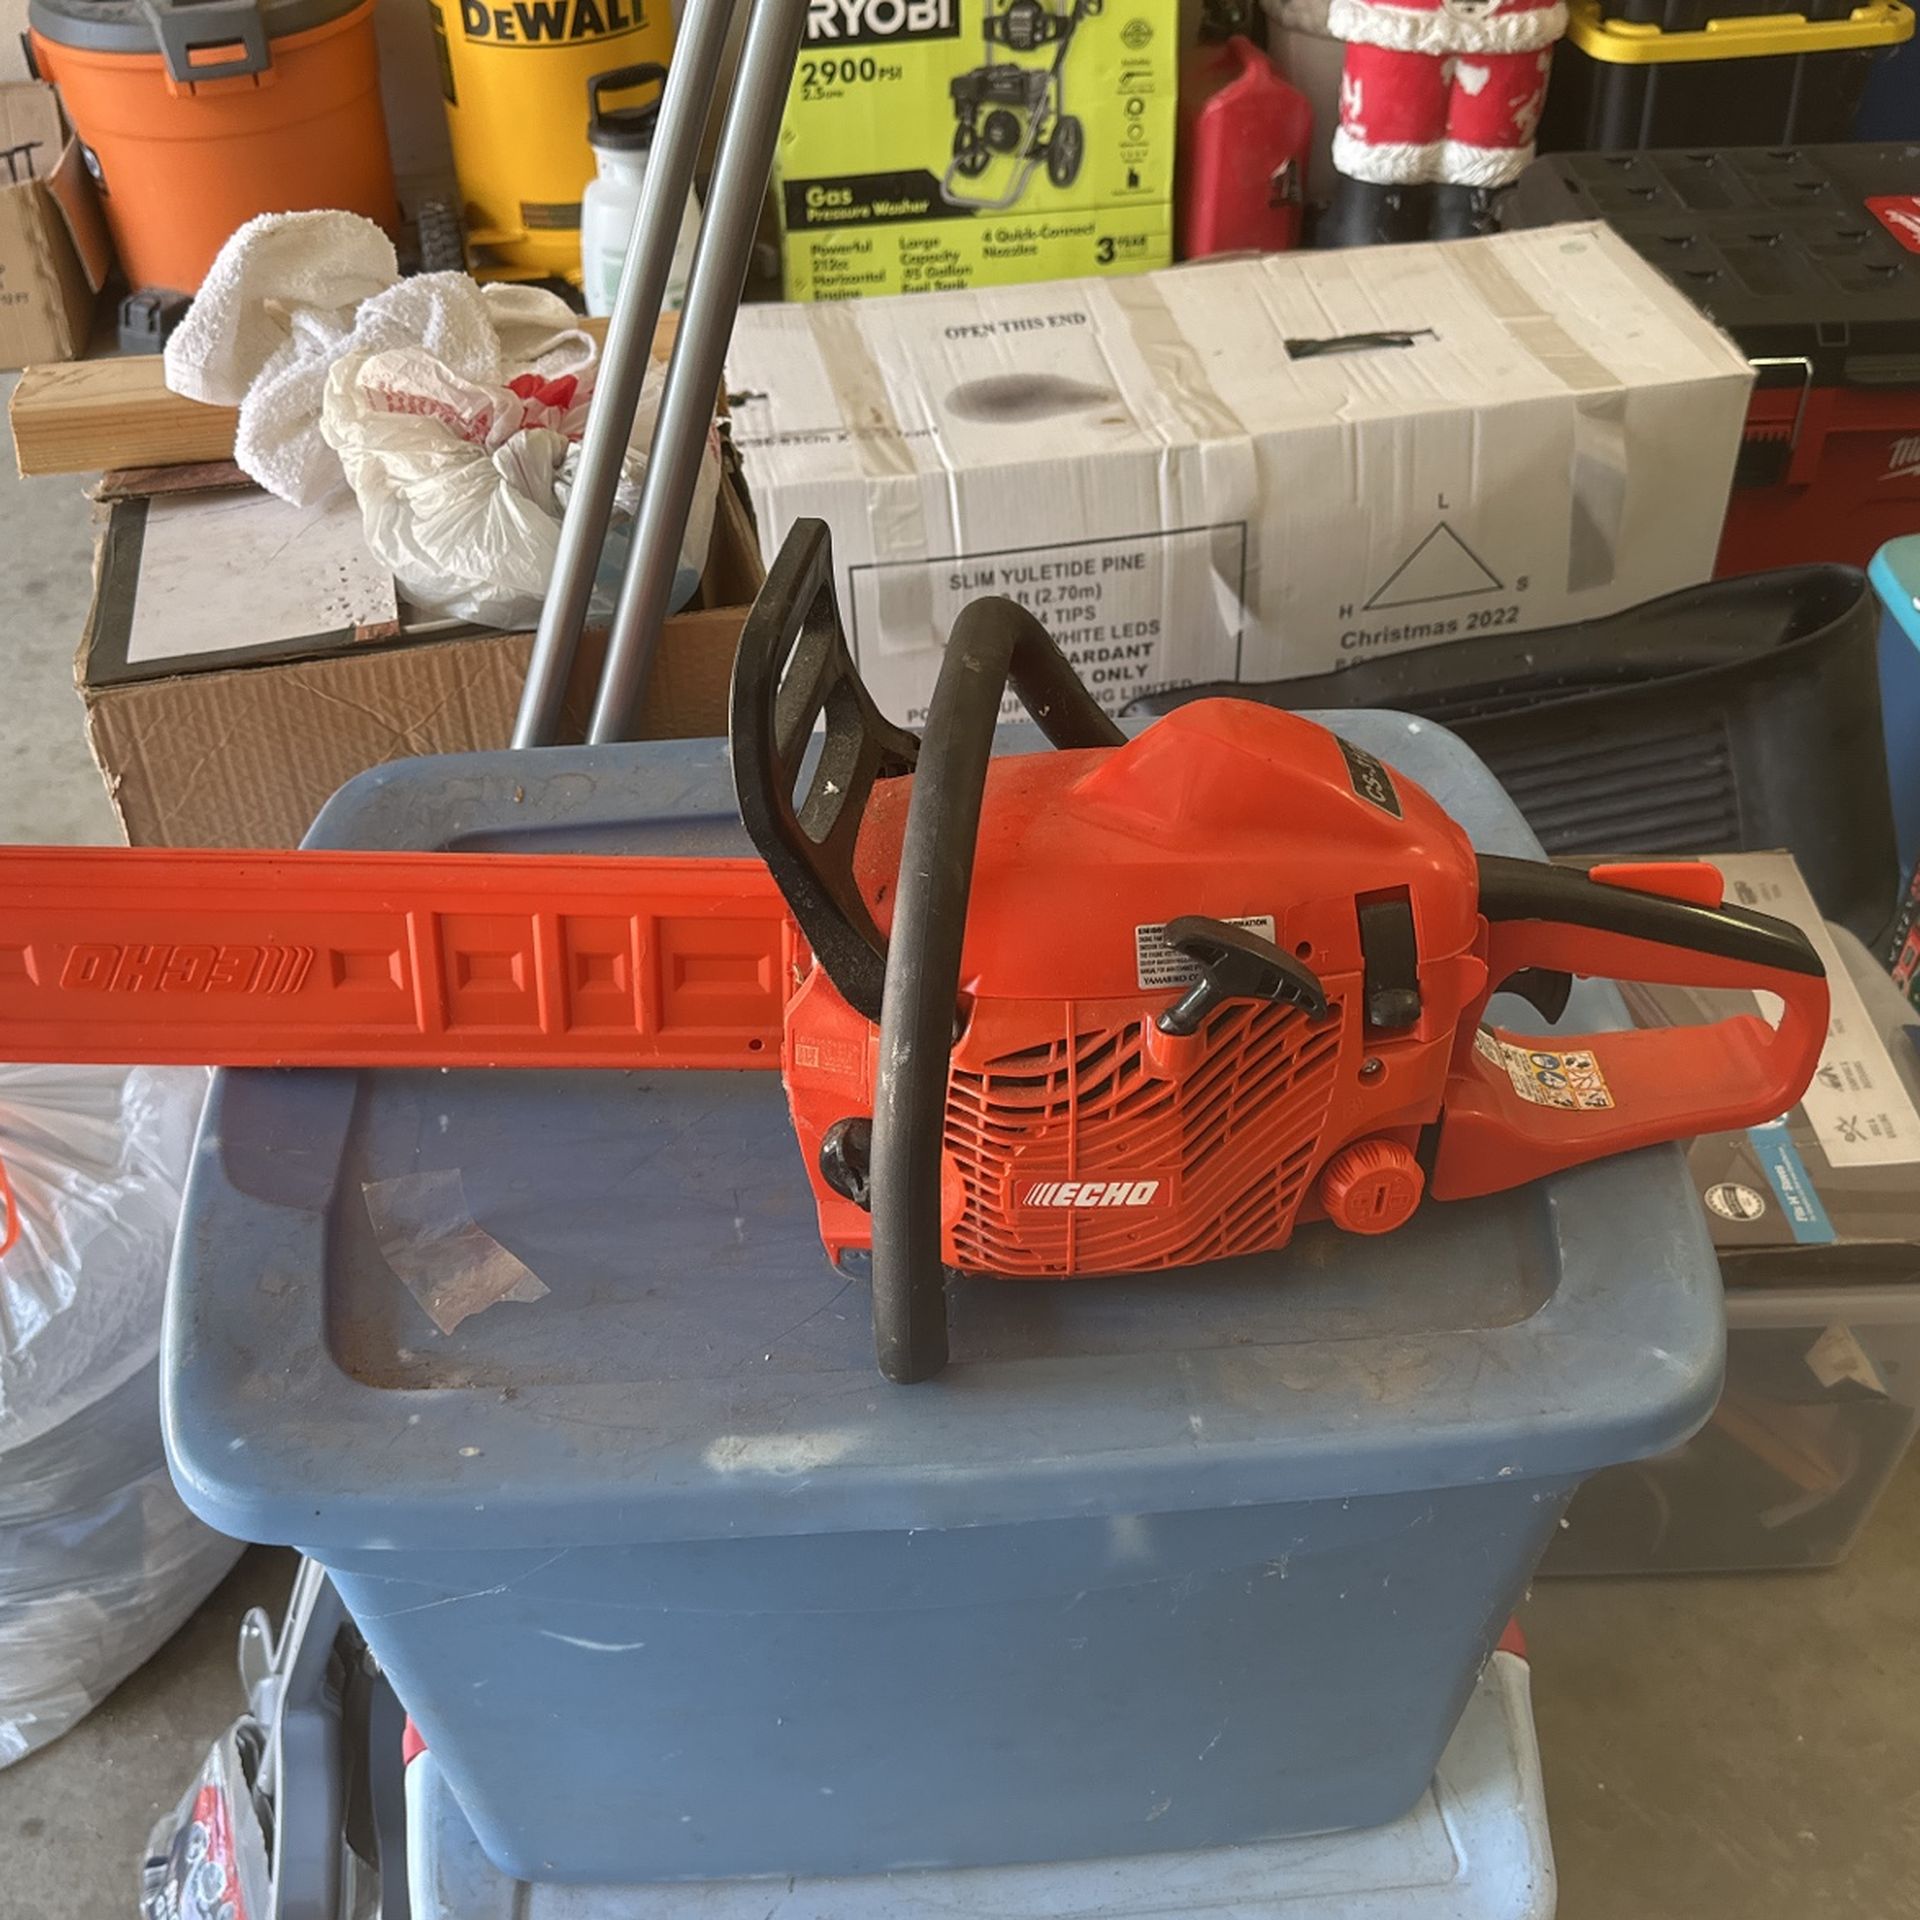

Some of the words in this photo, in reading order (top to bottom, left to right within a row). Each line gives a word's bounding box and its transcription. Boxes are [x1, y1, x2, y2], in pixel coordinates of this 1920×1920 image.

[807, 0, 951, 39] RYOBI
[801, 58, 876, 87] 2900
[805, 185, 853, 208] Gas
[806, 206, 871, 222] Pressure
[872, 198, 930, 217] Washer
[899, 236, 940, 252] Large
[1096, 236, 1115, 265] 3
[900, 249, 961, 267] Capacity
[944, 320, 996, 341] OPEN
[999, 316, 1045, 334] THIS
[1047, 311, 1087, 328] END
[1437, 492, 1450, 510] L
[950, 569, 996, 591] SLIM
[1001, 558, 1097, 585] YULETIDE
[1102, 552, 1146, 574] PINE
[1515, 575, 1530, 592] S
[1035, 583, 1102, 607] (2.70m)
[1055, 605, 1097, 624] TIPS
[1338, 603, 1354, 620] H
[1051, 625, 1105, 645] WHITE
[1111, 619, 1161, 640] LEDS
[1340, 619, 1458, 650] Christmas
[1466, 605, 1521, 632] 2022
[1065, 641, 1154, 665] ARDANT
[1092, 664, 1149, 684] ONLY
[58, 942, 260, 994] ECHO
[1051, 1180, 1160, 1208] ECHO
